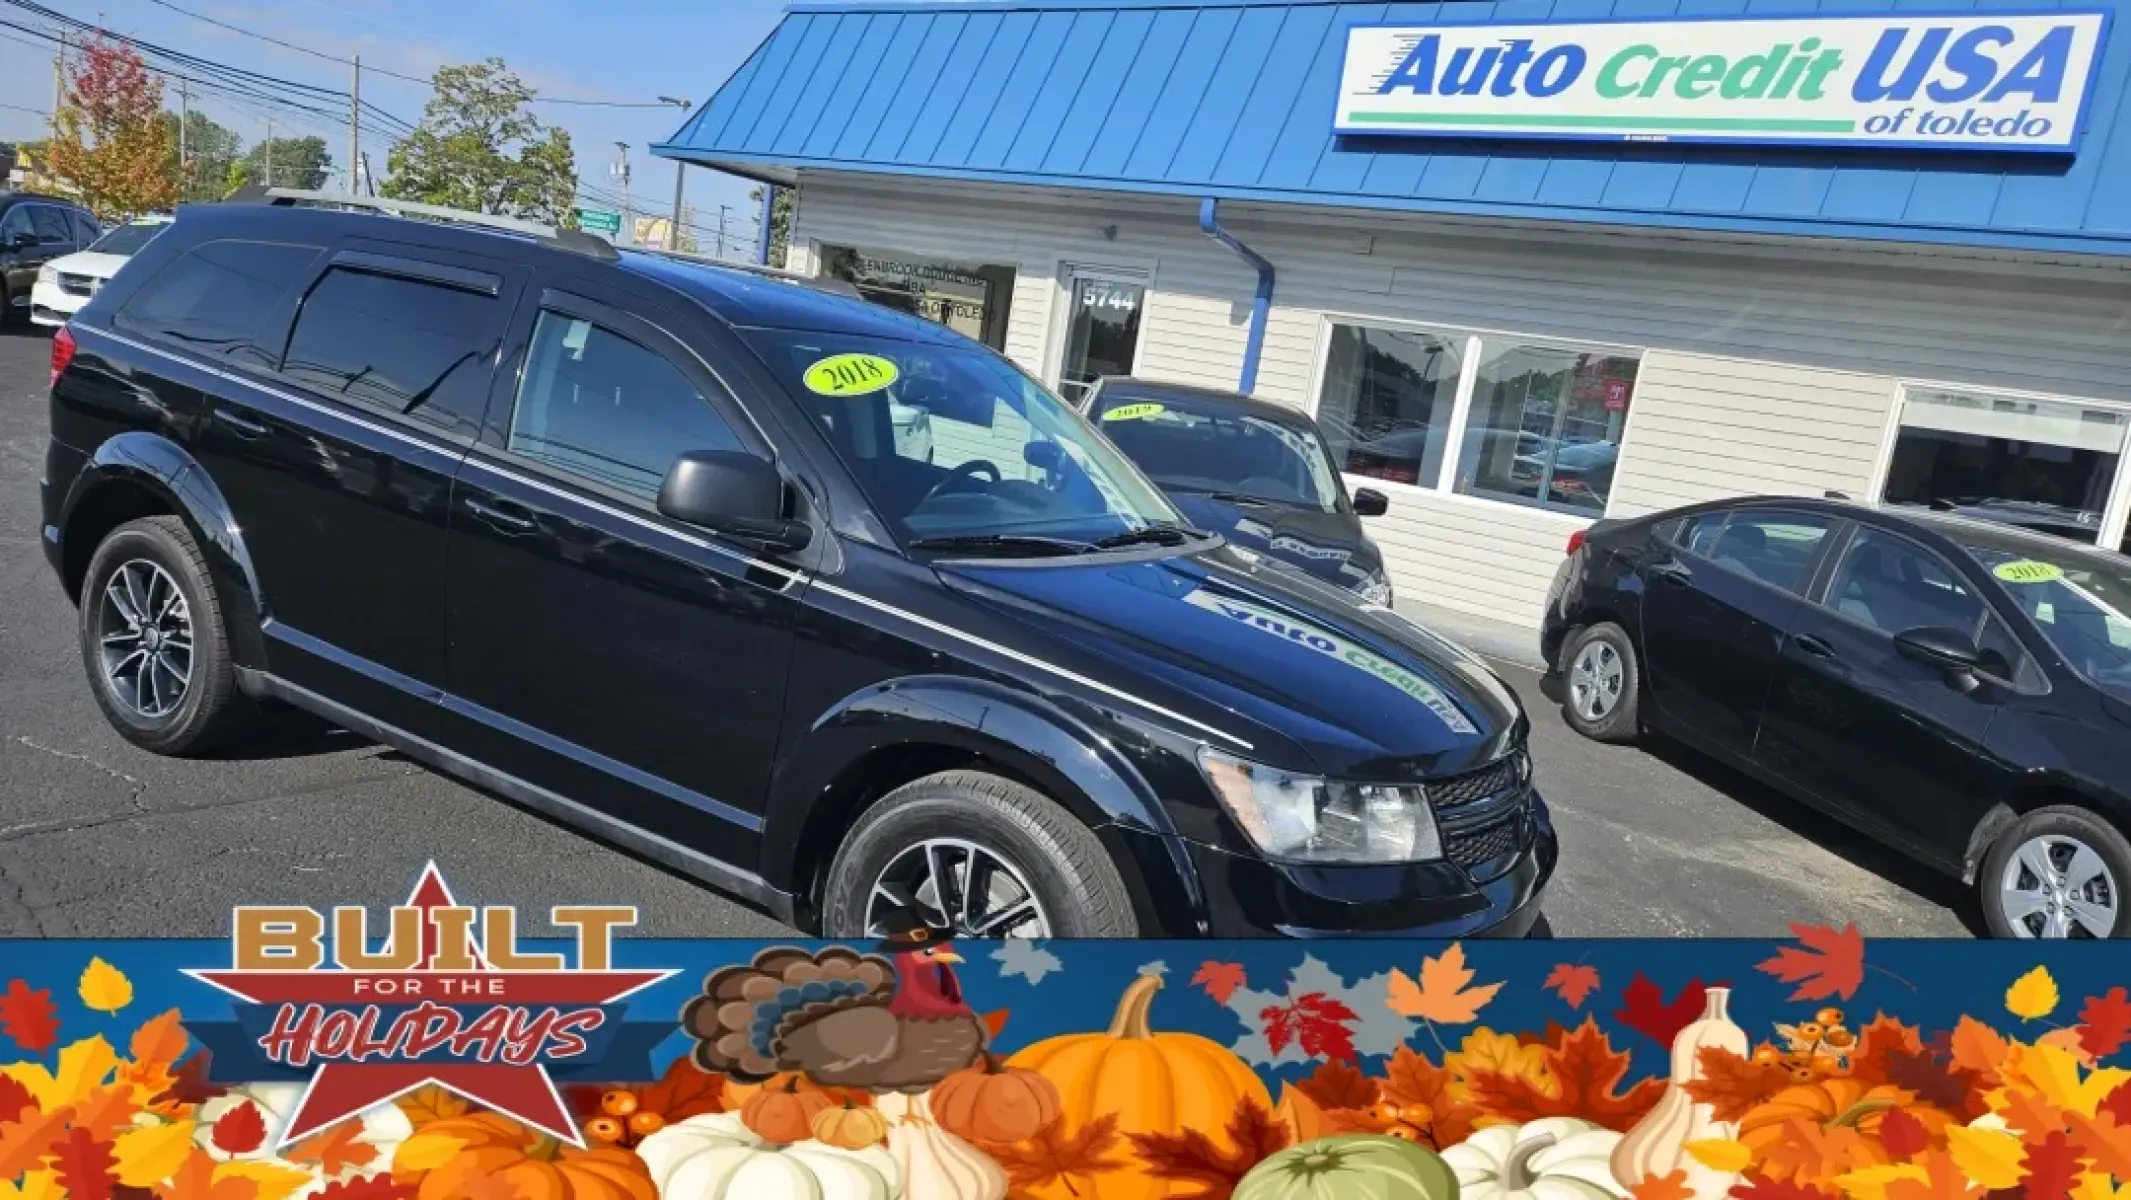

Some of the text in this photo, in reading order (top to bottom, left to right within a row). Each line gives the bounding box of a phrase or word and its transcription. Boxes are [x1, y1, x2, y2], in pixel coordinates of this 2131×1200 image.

[1374, 25, 2077, 104] Auto Credit USA
[1863, 107, 2053, 138] of toledo
[1082, 287, 1136, 311] 5744
[822, 358, 884, 391] 2018
[2004, 563, 2053, 580] 2018
